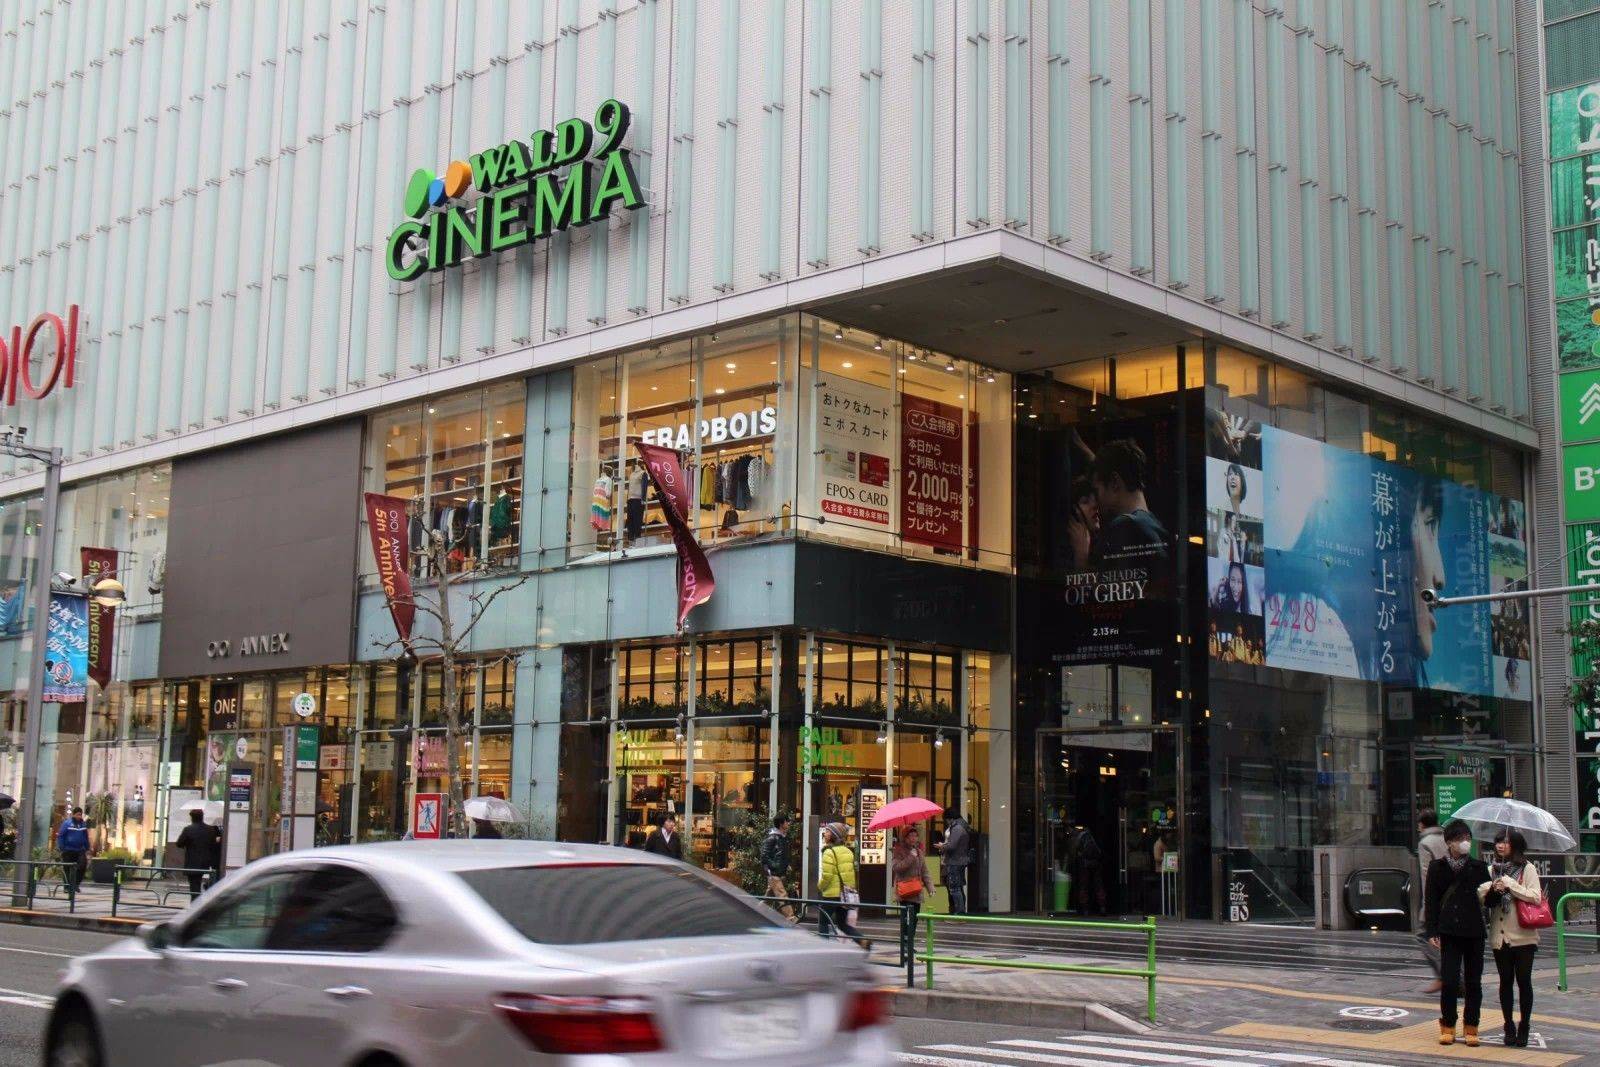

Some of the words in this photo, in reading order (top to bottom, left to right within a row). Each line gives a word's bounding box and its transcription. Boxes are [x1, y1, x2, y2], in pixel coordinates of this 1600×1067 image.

[469, 118, 593, 193] WALD
[593, 99, 630, 159] 9
[386, 148, 647, 282] CINEMA
[0, 304, 79, 406] IOI
[823, 392, 889, 420] おトクなカード
[910, 413, 956, 435] ご入会特典
[908, 438, 942, 456] 本日から
[826, 483, 855, 501] EPOS
[859, 490, 889, 507] CARD
[375, 508, 387, 532] 5th
[907, 517, 949, 536] プレゼント
[1066, 572, 1099, 586] FIFTY
[1102, 567, 1148, 582] SHADES
[1371, 472, 1397, 674] 幕が上がる
[1065, 585, 1092, 606] OF
[1095, 580, 1148, 603] GREY
[1268, 595, 1316, 633] 2.28
[1093, 627, 1109, 637] 2.13
[240, 632, 289, 657] ANNEX
[213, 698, 237, 715] ONE
[799, 726, 843, 746] PAUL
[799, 745, 856, 767] SMITH
